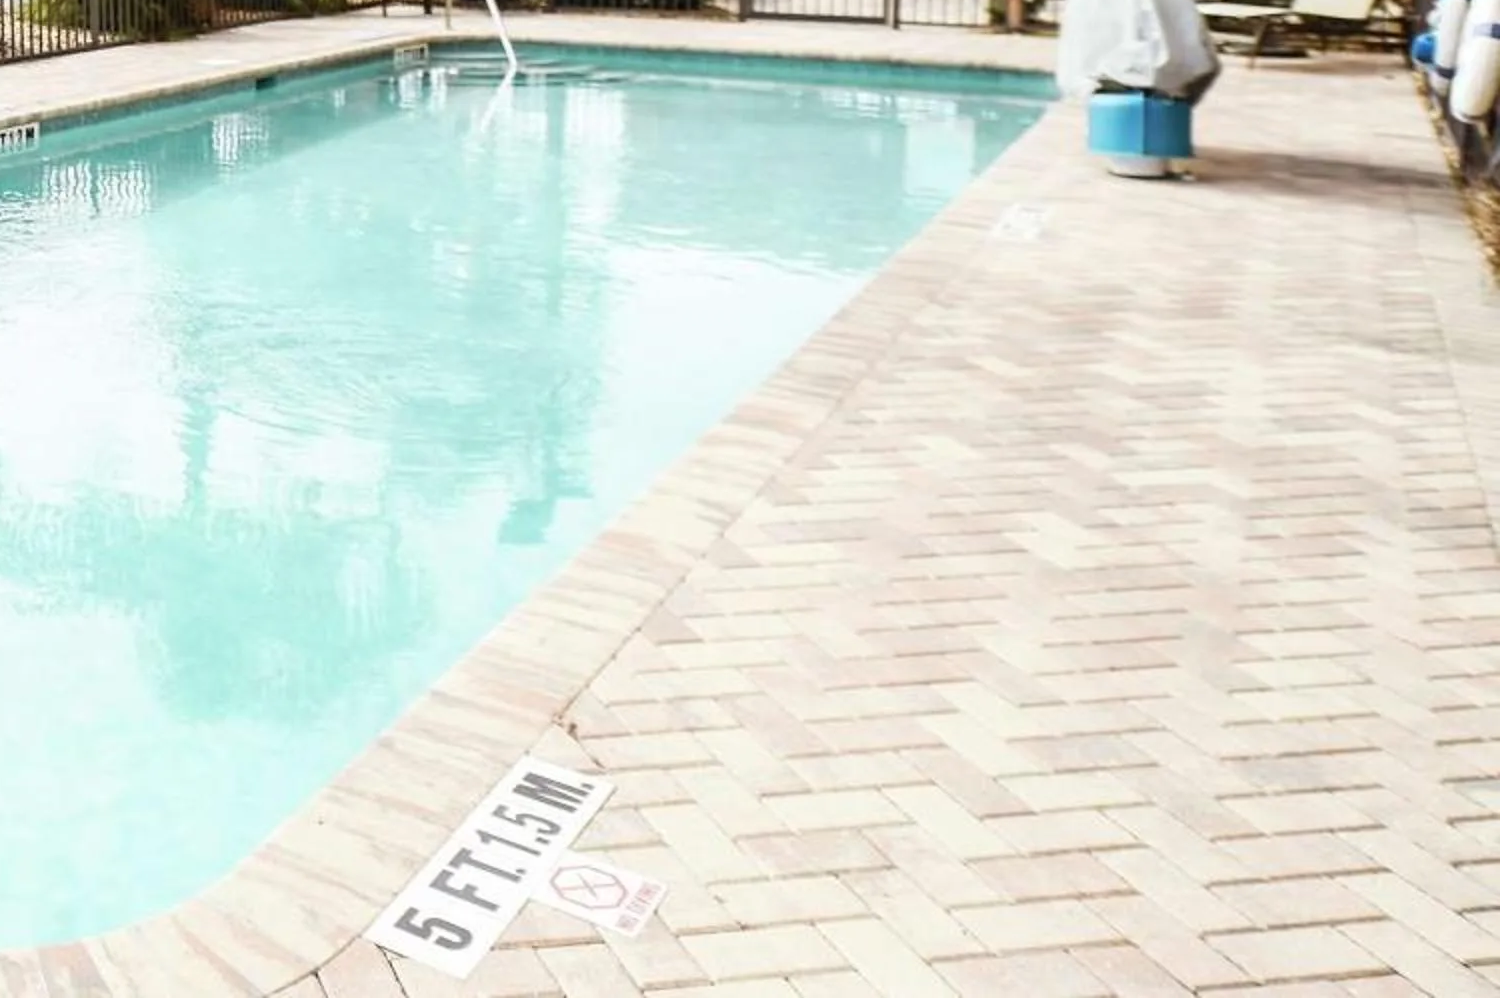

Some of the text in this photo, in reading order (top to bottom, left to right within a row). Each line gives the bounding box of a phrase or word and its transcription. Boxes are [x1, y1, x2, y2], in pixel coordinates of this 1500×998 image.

[394, 771, 595, 951] 5 FT. 1.5 M.
